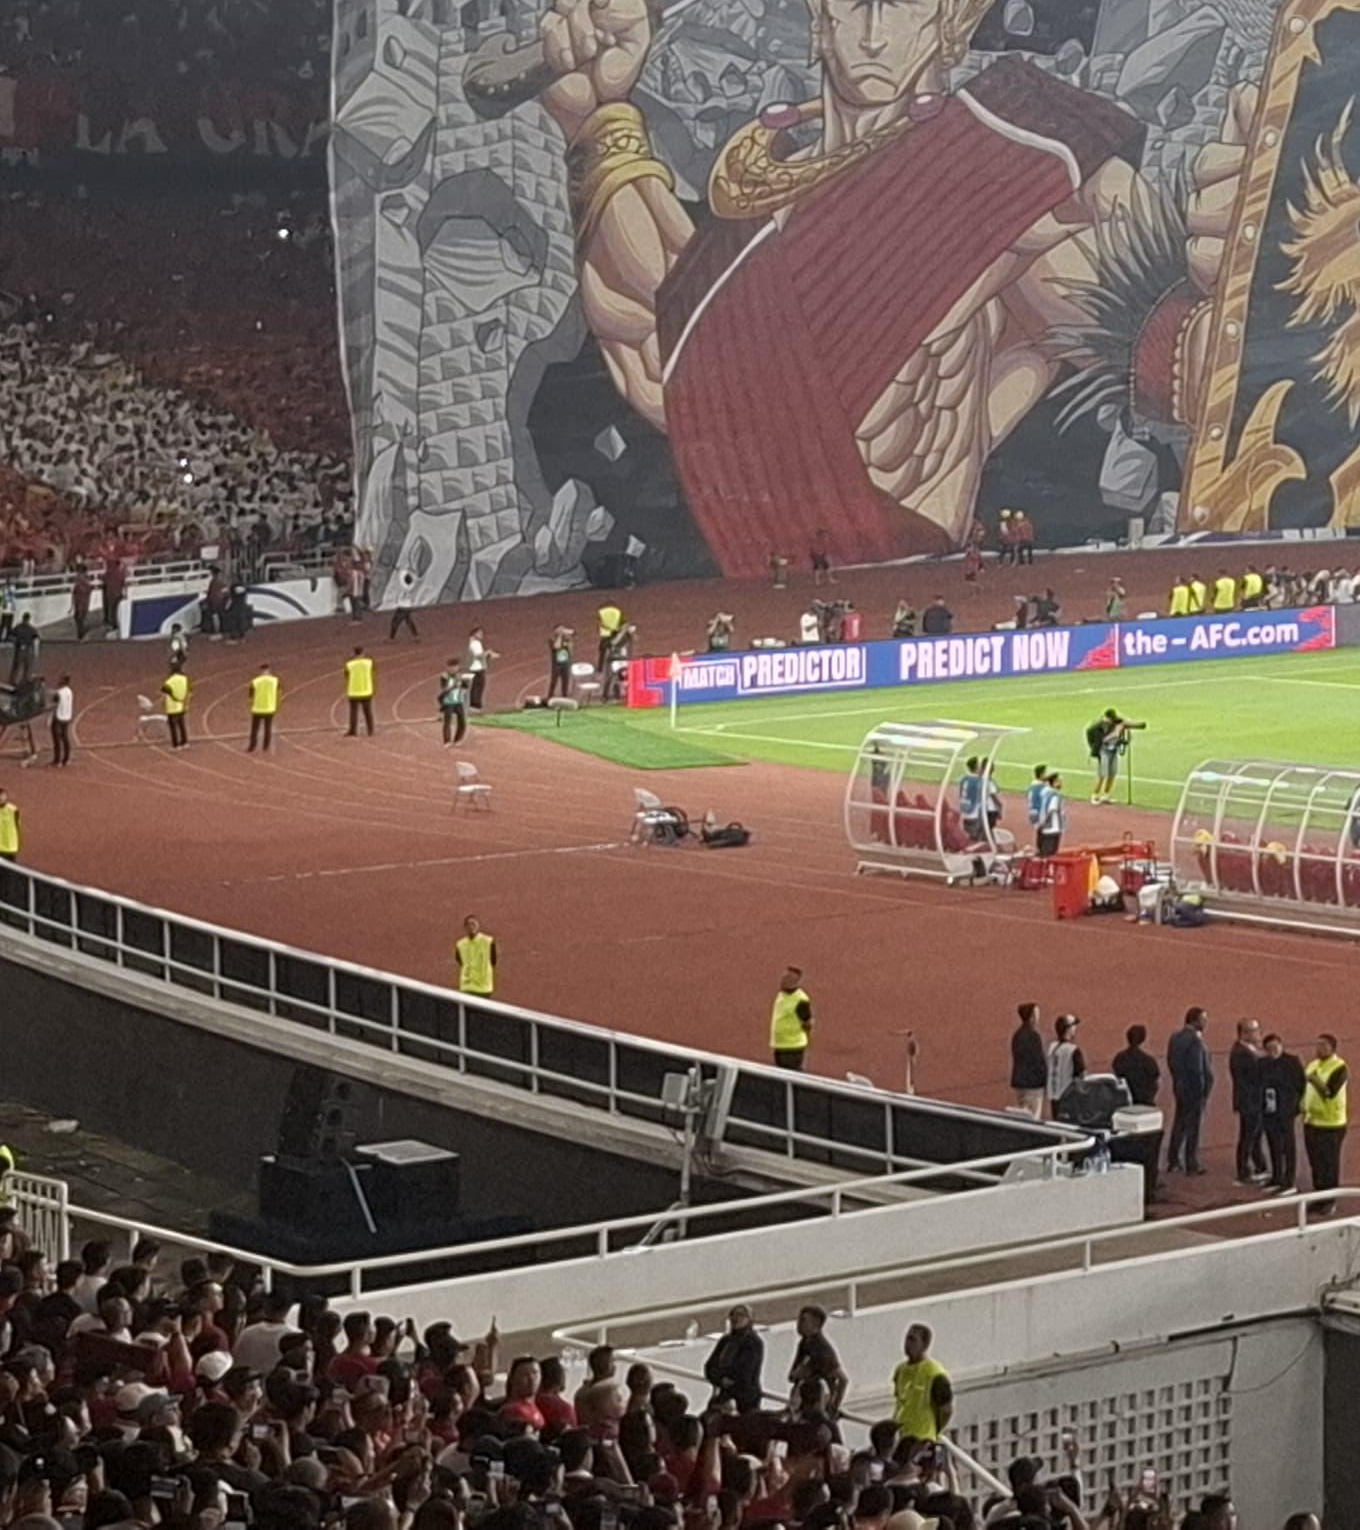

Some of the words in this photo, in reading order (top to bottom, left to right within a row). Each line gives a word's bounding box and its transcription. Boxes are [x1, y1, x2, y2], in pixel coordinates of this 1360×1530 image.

[683, 663, 735, 690] MATCH
[742, 646, 861, 688] PREDICTOR
[900, 634, 1002, 681] PREDICT
[1012, 630, 1071, 672] NOW
